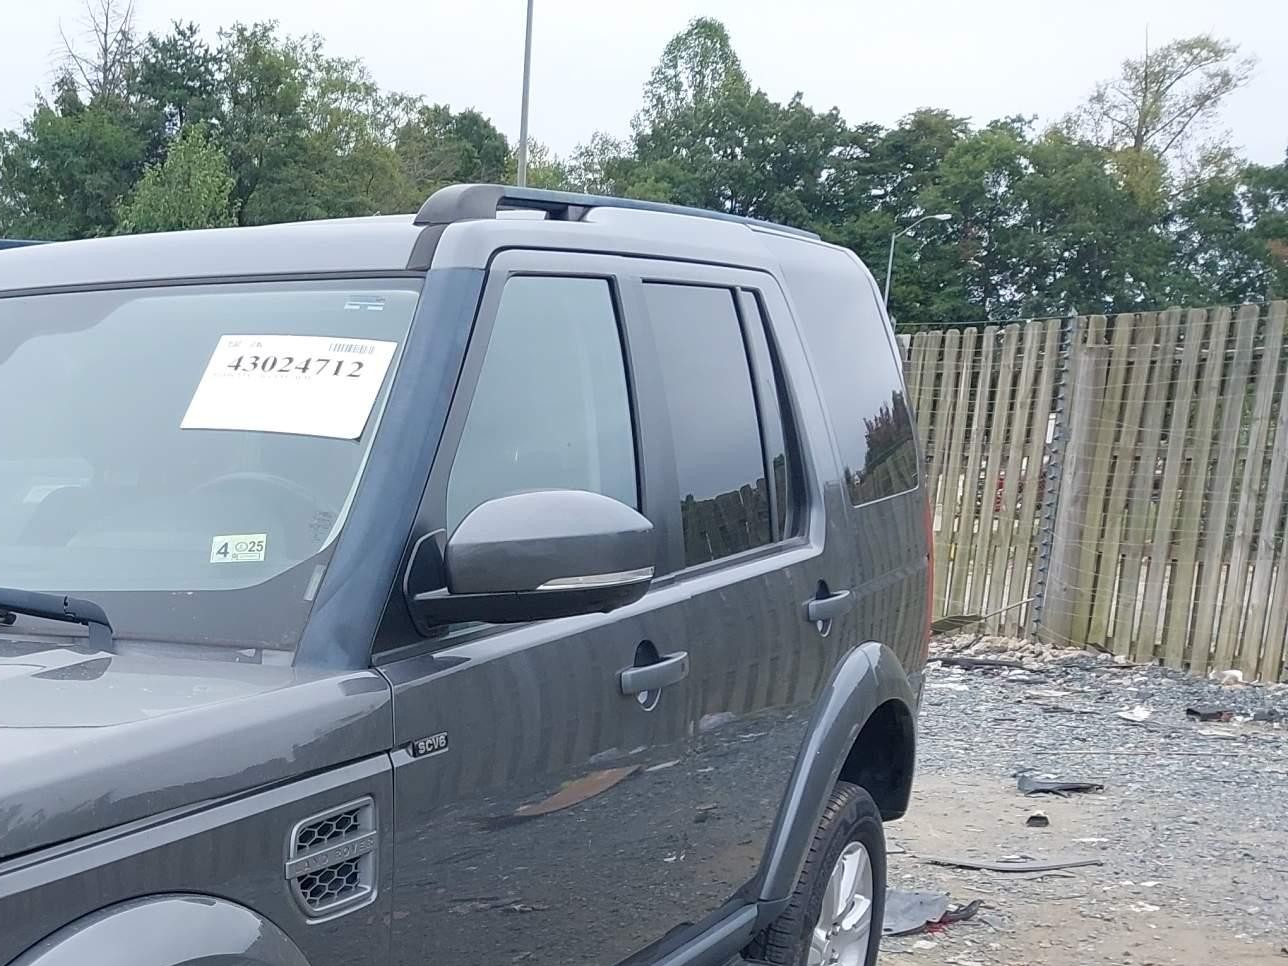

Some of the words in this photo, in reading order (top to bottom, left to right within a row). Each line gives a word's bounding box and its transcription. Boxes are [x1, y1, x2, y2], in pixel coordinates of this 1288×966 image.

[227, 355, 364, 378] 43024712
[215, 542, 230, 558] 4
[248, 540, 264, 552] 25
